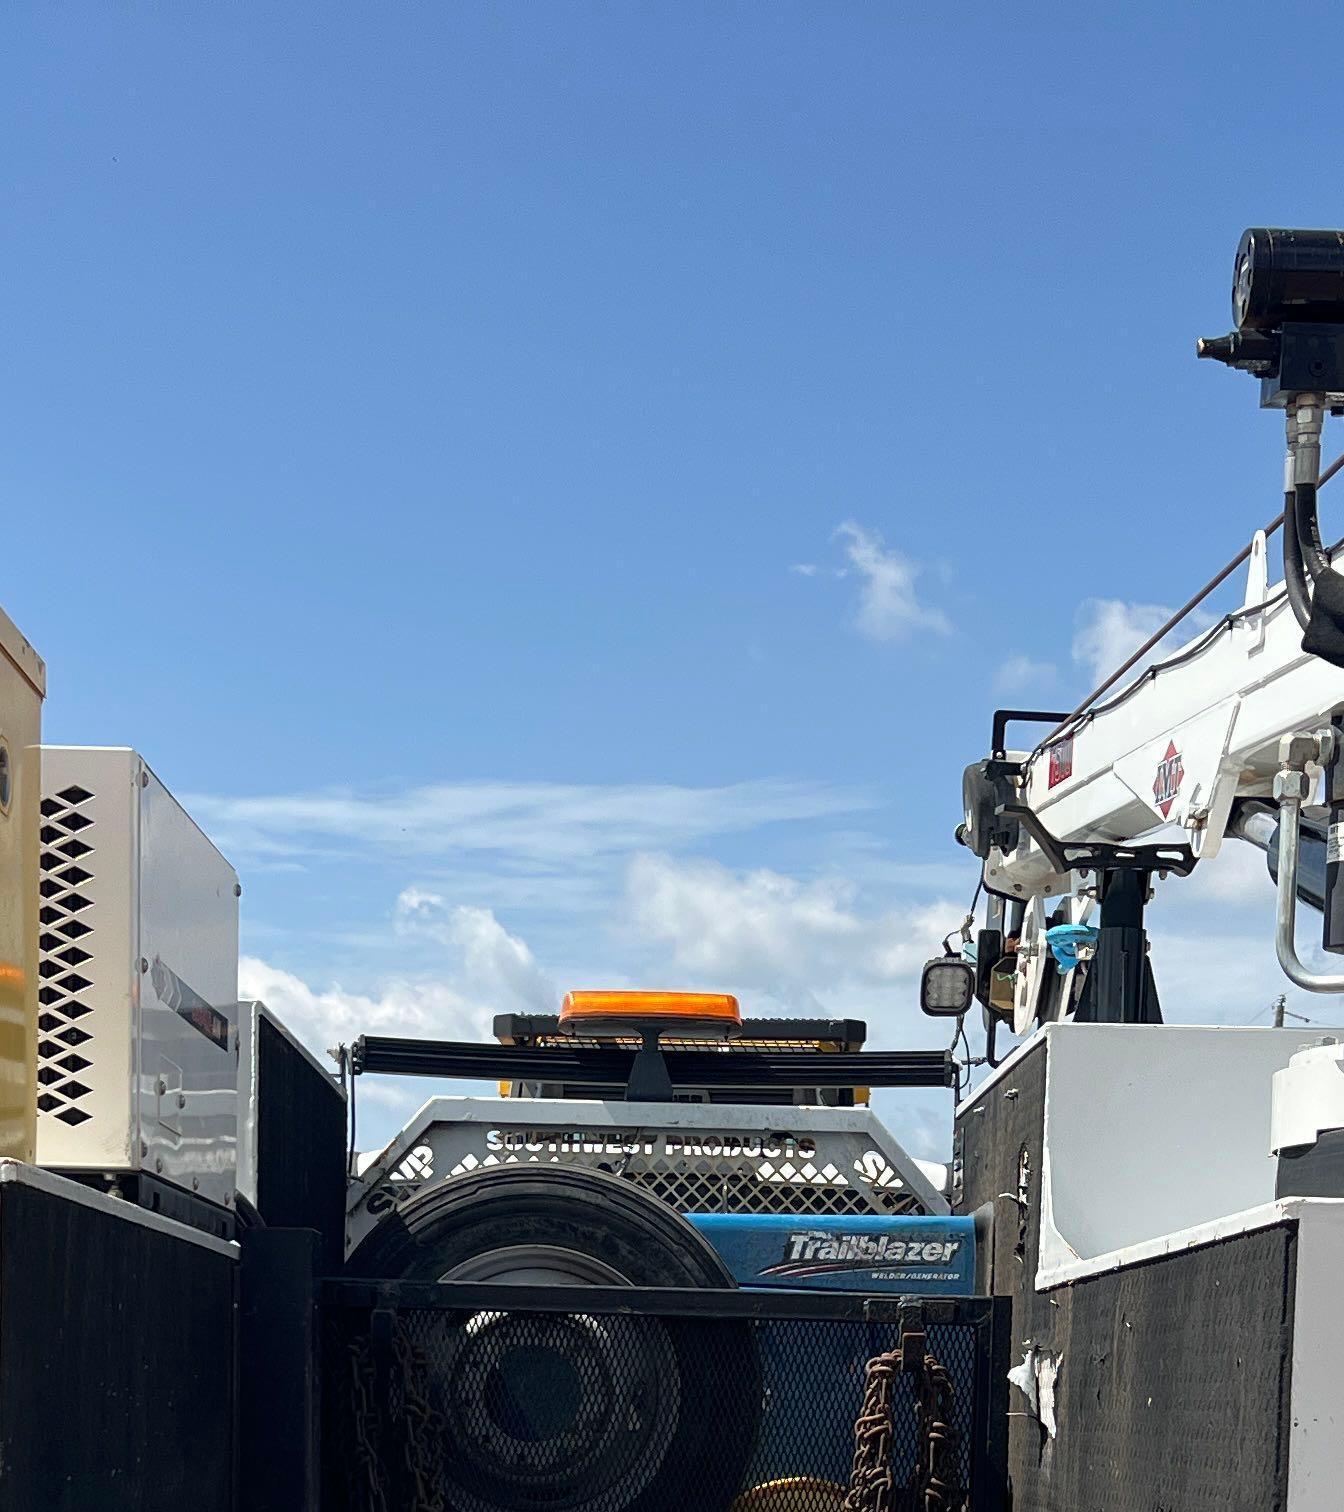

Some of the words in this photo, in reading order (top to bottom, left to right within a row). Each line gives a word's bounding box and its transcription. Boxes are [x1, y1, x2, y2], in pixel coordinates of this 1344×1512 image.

[485, 1129, 655, 1155] SOUTHWEST
[664, 1134, 817, 1159] PRODUCTS
[789, 1232, 960, 1263] Trailblazer
